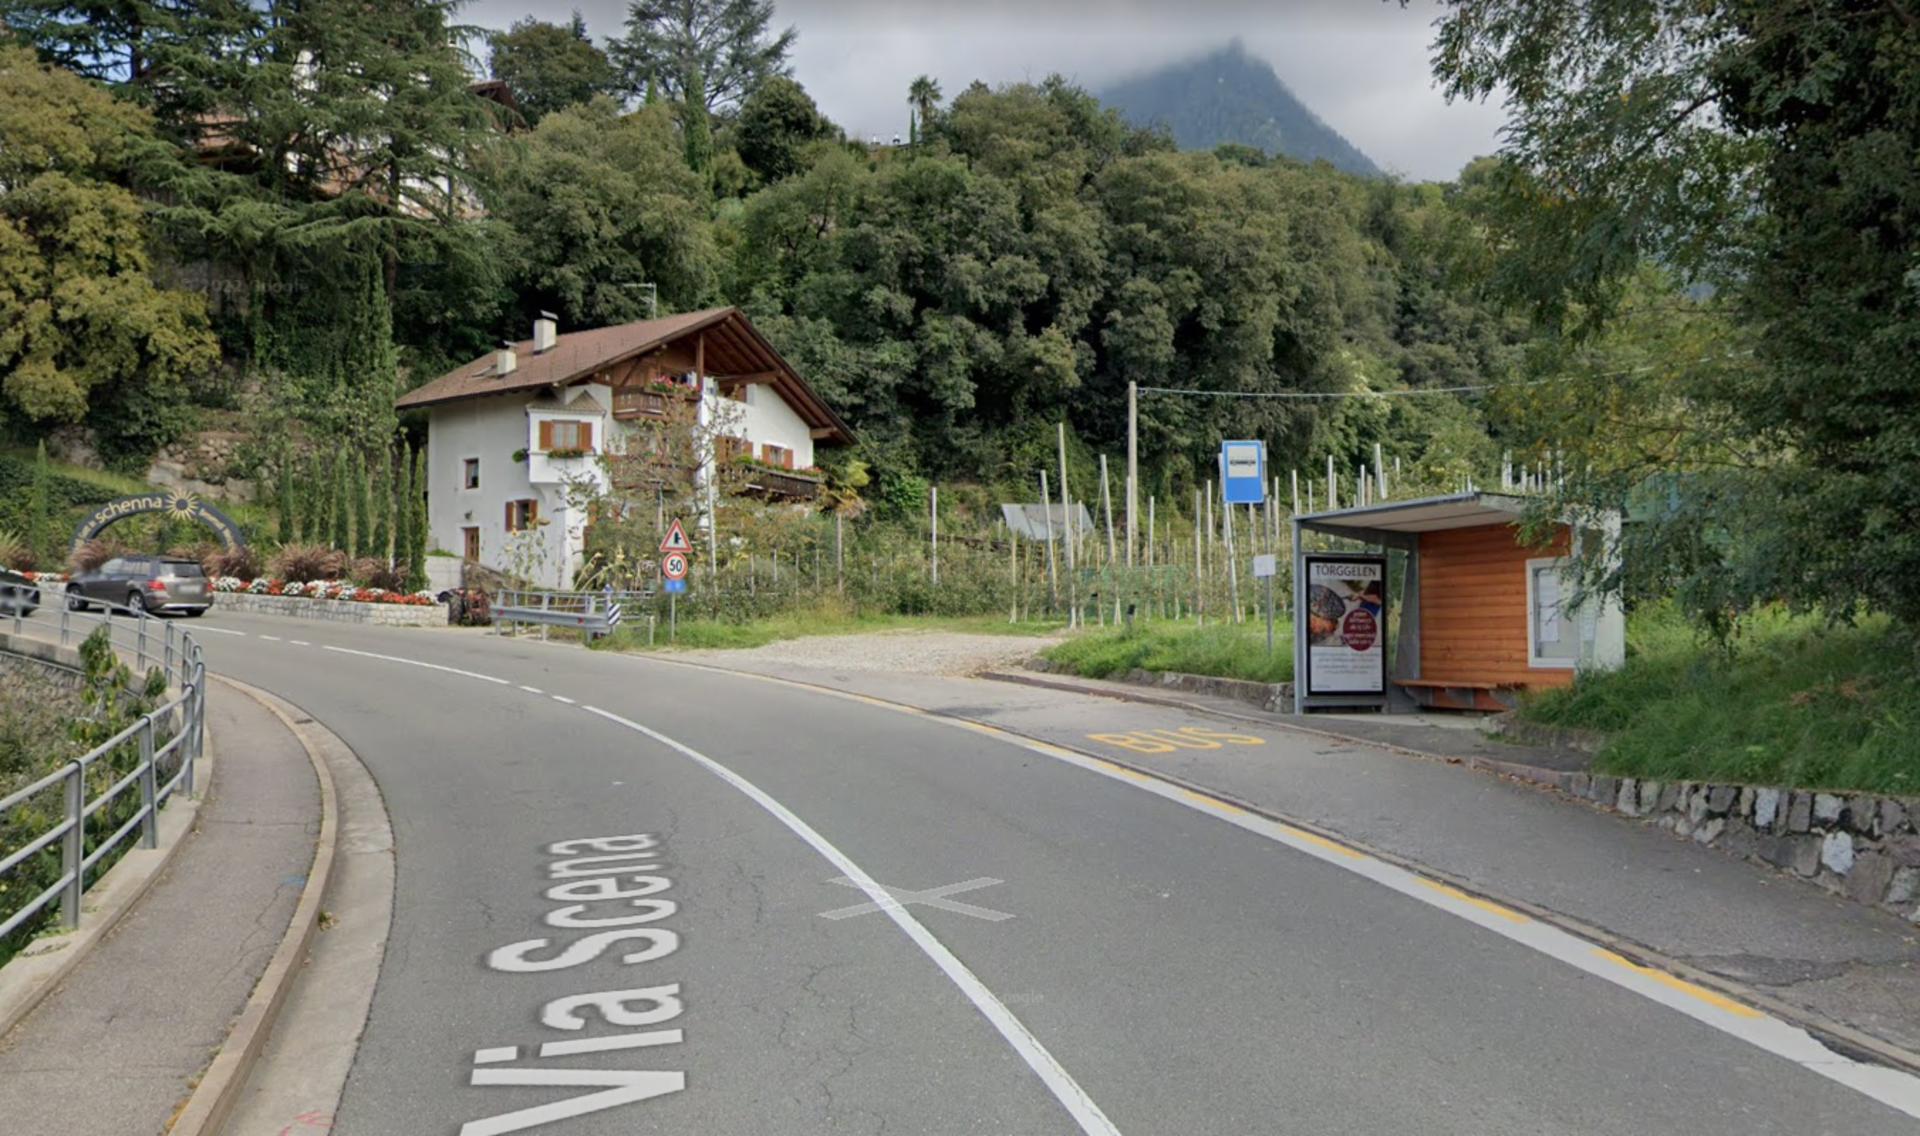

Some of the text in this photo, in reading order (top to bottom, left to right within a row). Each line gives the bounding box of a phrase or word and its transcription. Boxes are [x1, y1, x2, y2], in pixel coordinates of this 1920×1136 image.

[95, 497, 162, 523] schenna
[669, 559, 682, 572] 50
[1086, 726, 1266, 753] BUS
